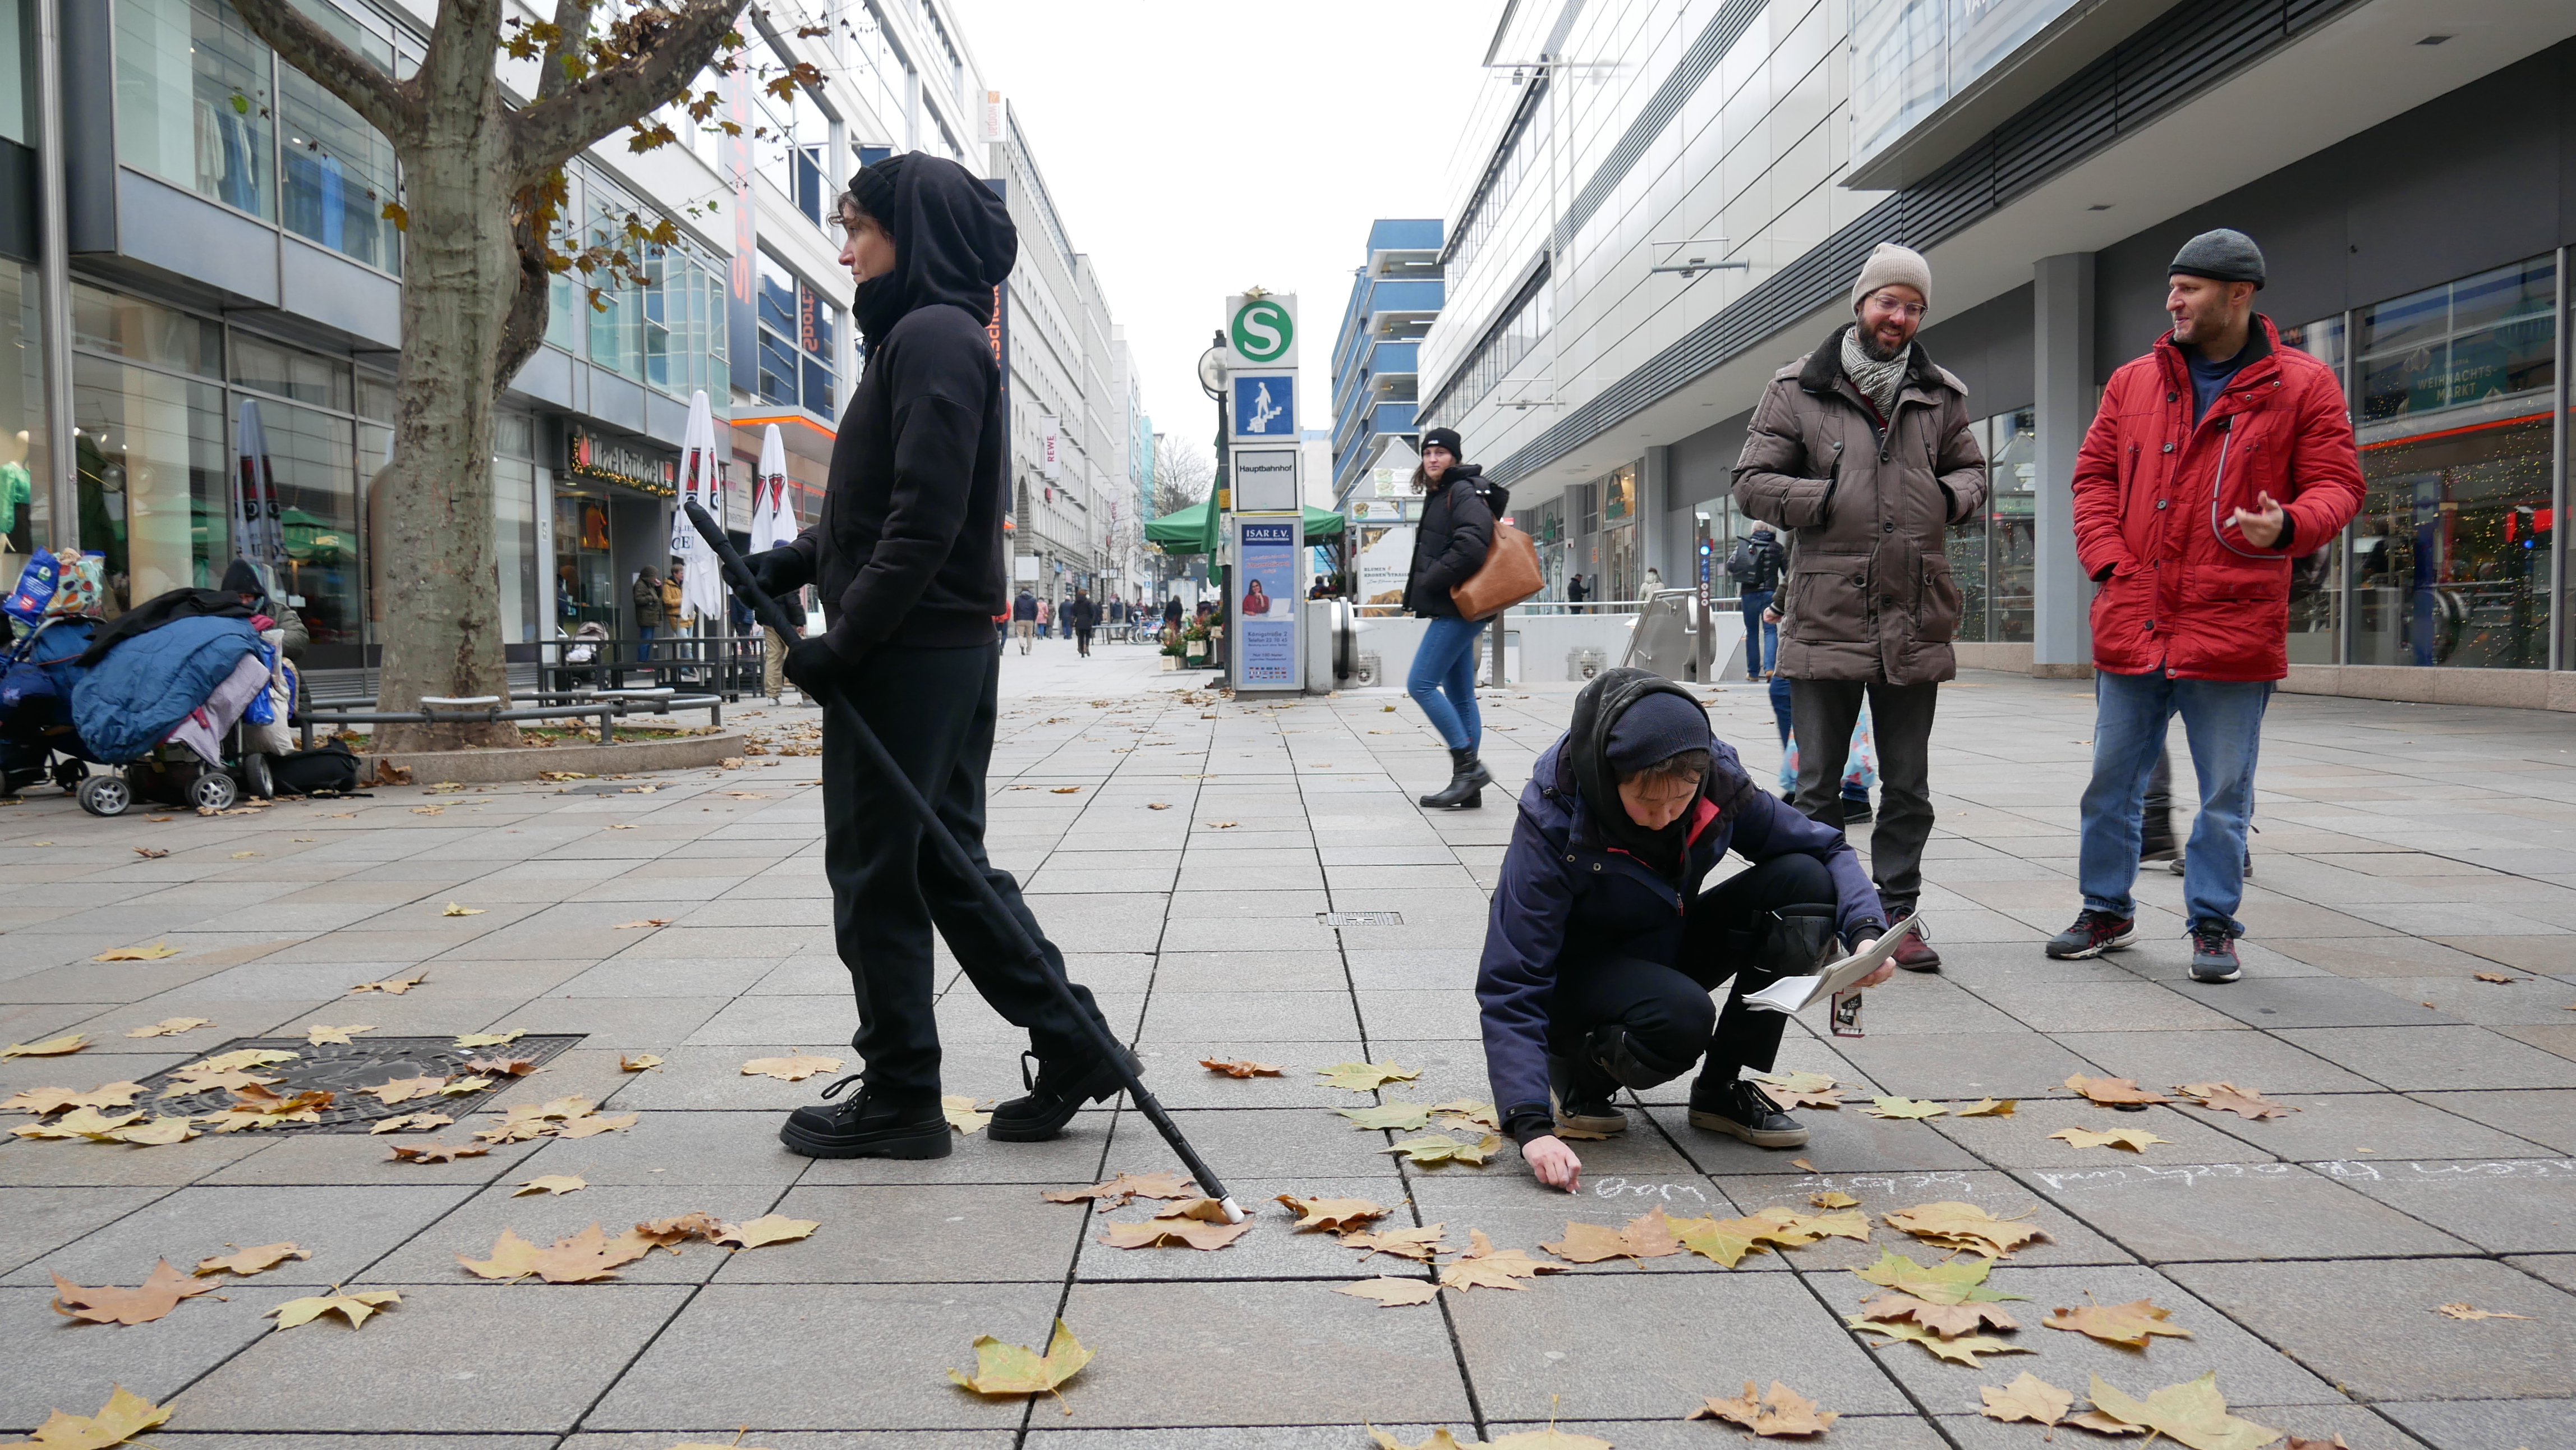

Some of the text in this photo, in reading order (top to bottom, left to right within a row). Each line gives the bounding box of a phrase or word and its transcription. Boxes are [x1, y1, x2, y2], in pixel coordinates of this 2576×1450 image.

[1243, 306, 1282, 355] S
[2417, 365, 2498, 390] WEIHNACHTS-
[2437, 382, 2476, 401] MARKT
[1239, 465, 1292, 473] Hauptbahnhof
[1847, 999, 1858, 1009] ABC
